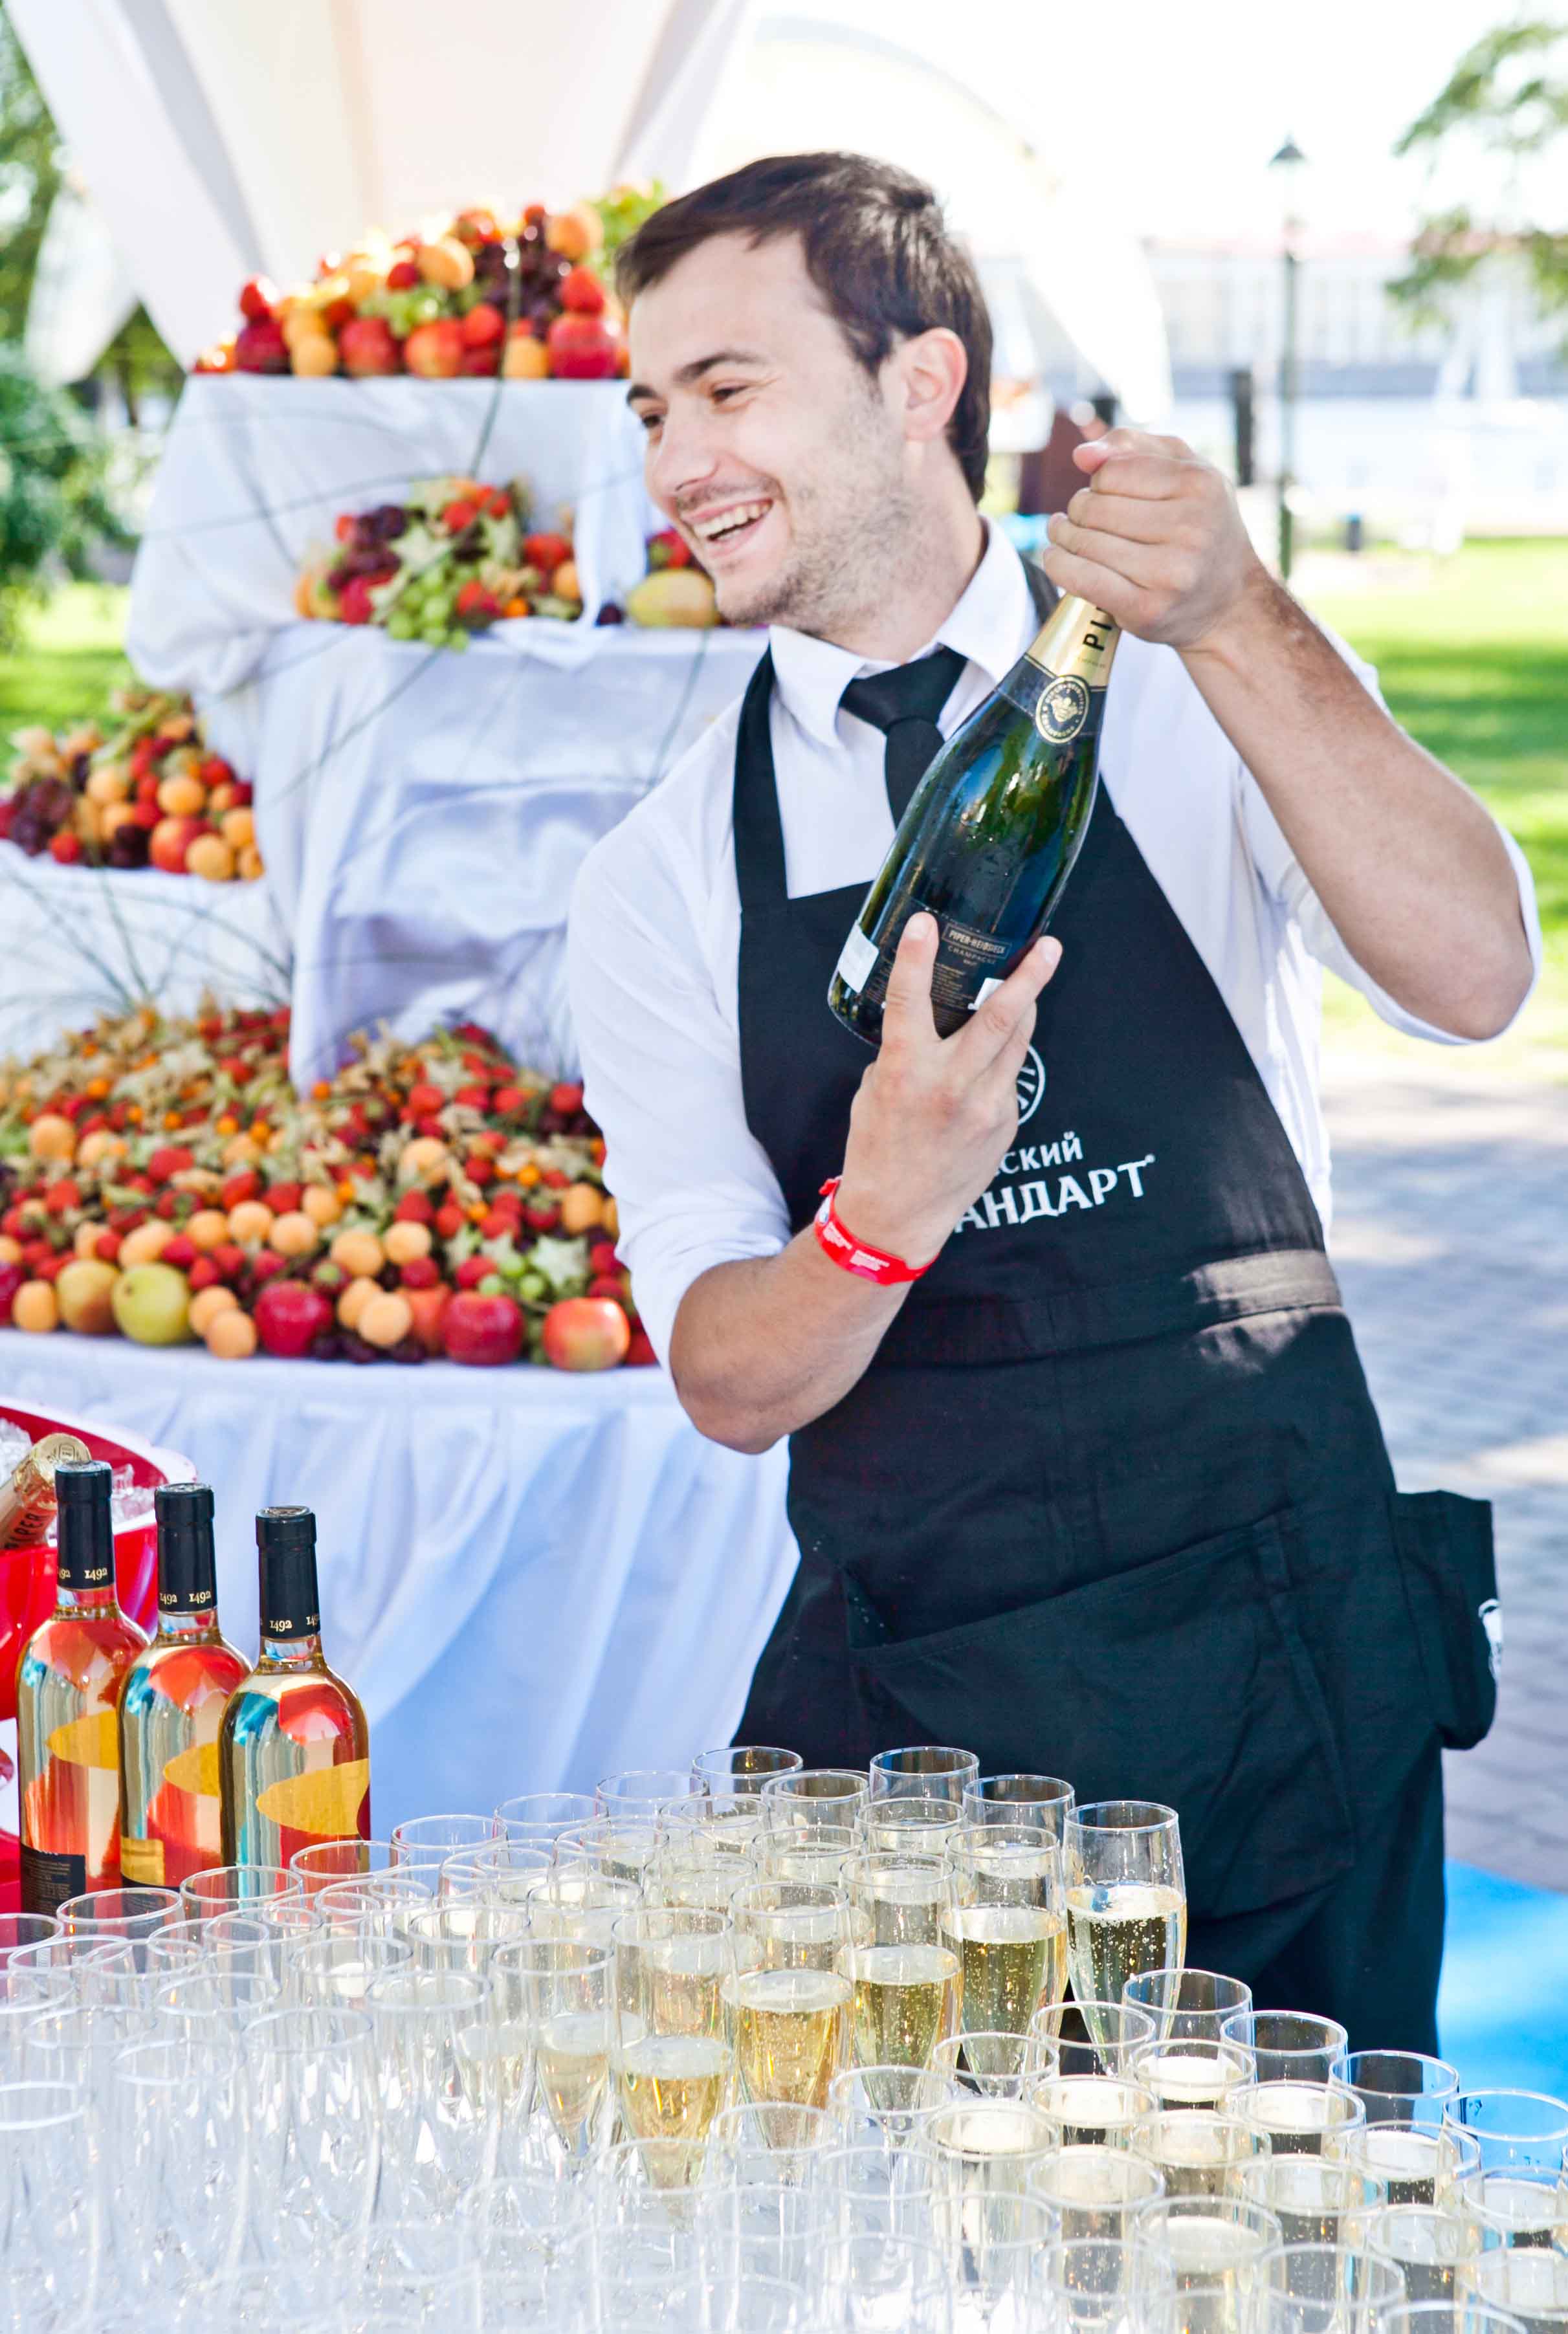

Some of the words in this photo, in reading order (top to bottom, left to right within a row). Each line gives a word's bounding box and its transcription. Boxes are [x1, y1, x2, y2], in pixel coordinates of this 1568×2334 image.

[995, 1130, 1083, 1177] СКИЙ
[83, 1567, 108, 1581] 1492
[189, 1590, 212, 1604] 1492
[269, 1620, 293, 1632] 1492
